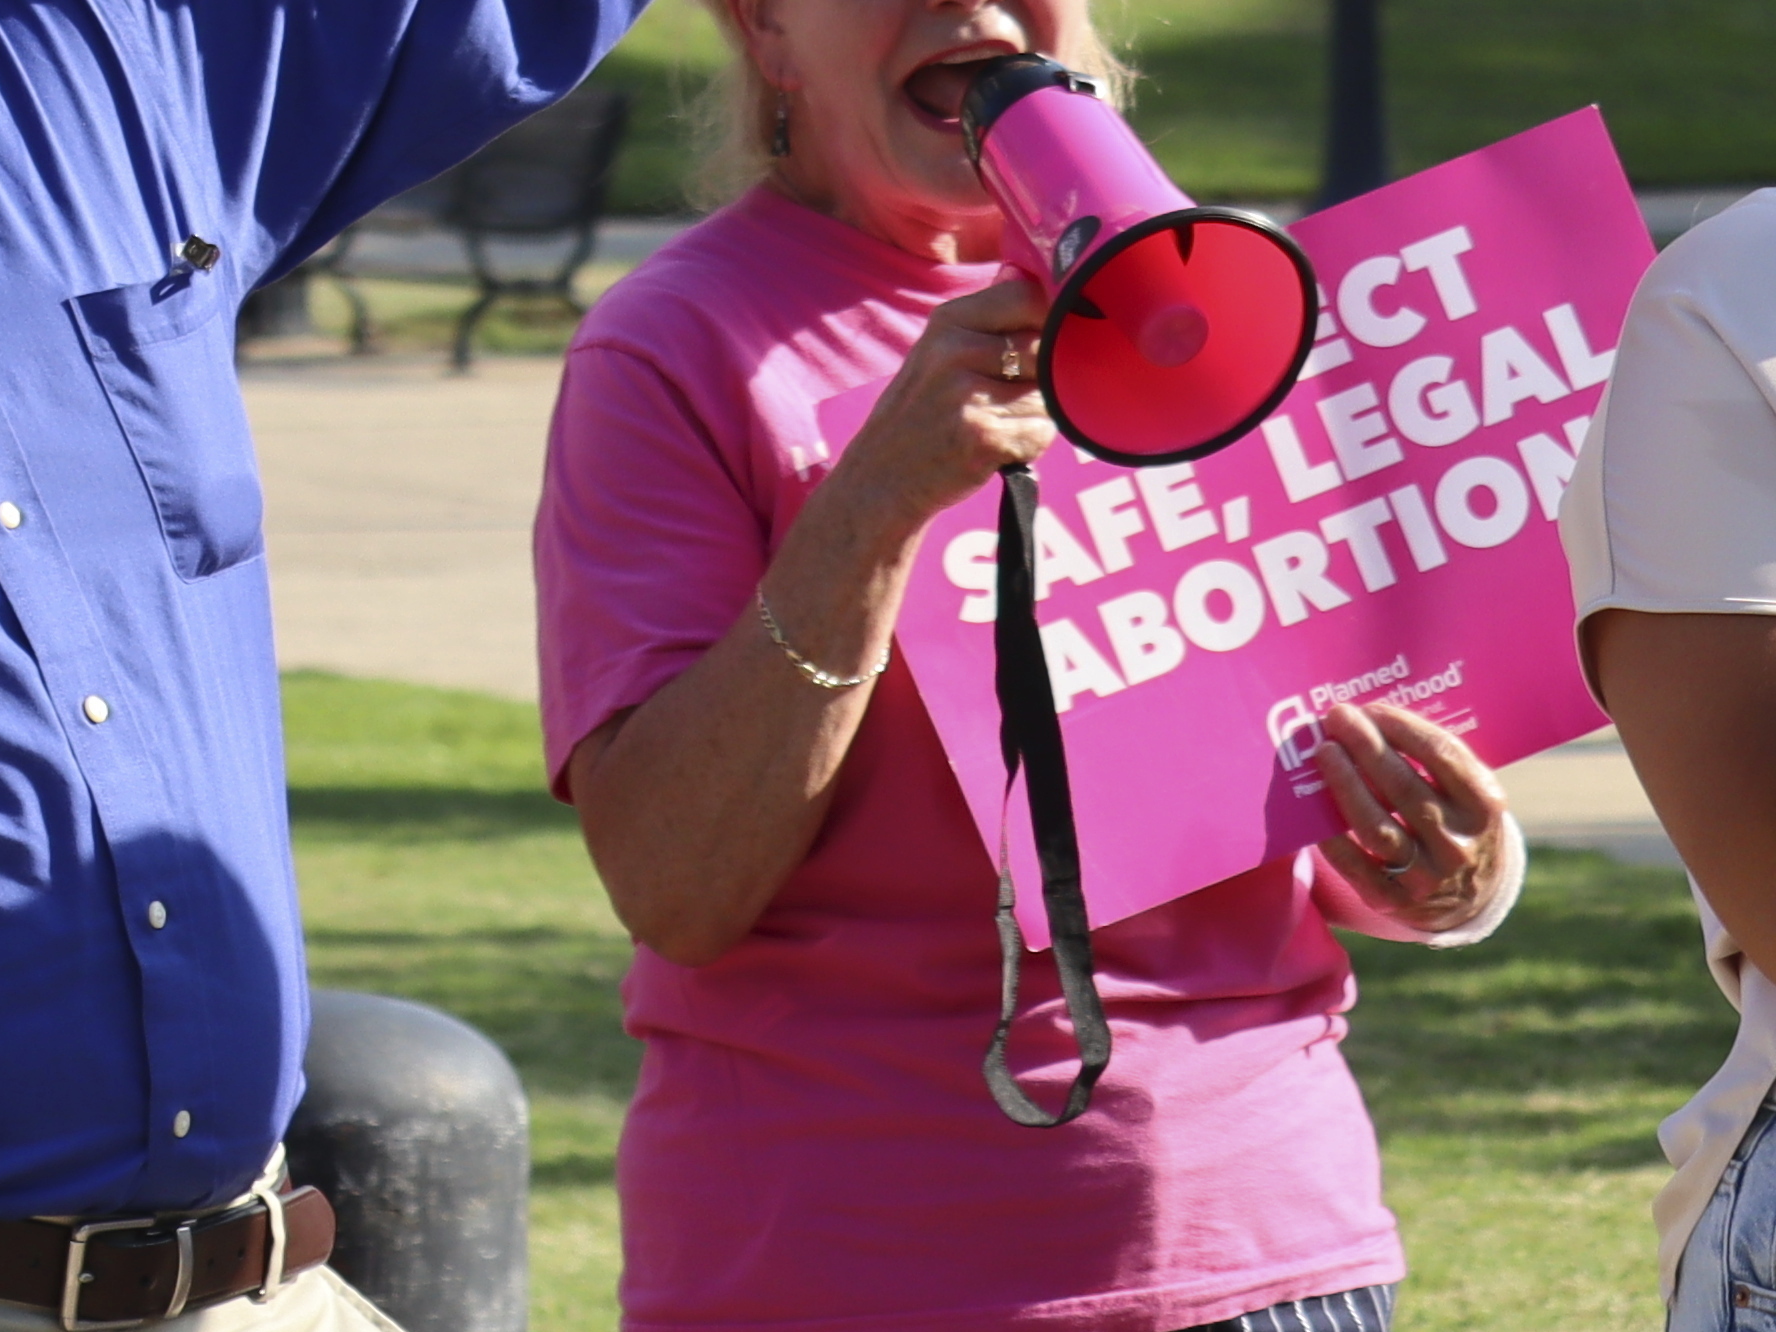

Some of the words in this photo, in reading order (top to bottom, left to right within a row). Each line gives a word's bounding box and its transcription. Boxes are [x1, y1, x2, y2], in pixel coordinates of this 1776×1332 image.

[943, 462, 1250, 625] SAFE,
[1261, 302, 1617, 505] LEGAL
[1309, 653, 1411, 711] Planned
